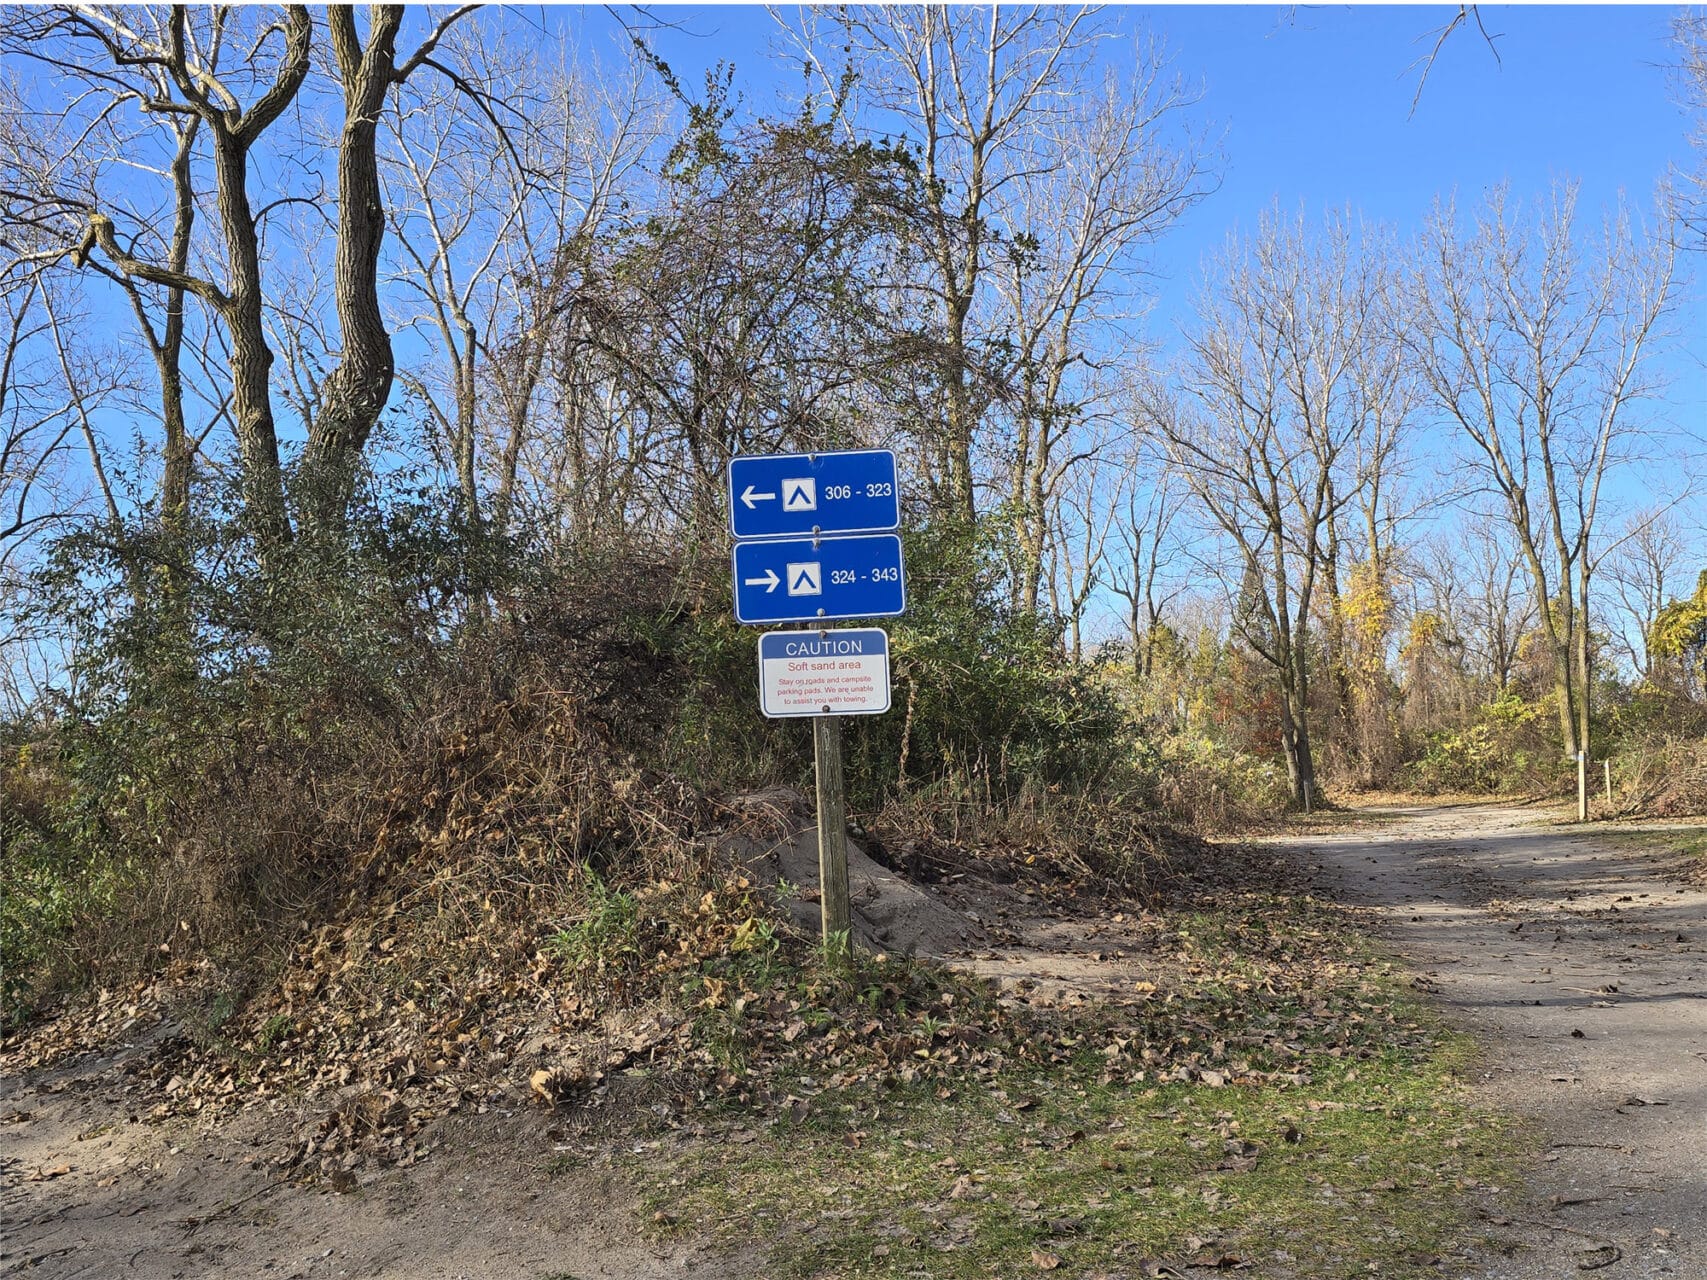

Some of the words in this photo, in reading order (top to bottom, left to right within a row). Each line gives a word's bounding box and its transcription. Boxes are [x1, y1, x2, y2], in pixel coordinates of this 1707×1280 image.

[825, 486, 851, 499] 306
[866, 484, 892, 497] 323
[831, 570, 856, 584] 324
[872, 568, 897, 582] 343
[786, 641, 862, 655] CAUTION
[788, 662, 808, 671] Soft
[811, 661, 836, 670] sand
[839, 661, 861, 670] area
[779, 678, 793, 687] Stay
[805, 677, 825, 685] roads
[841, 675, 871, 685] campsite
[777, 687, 802, 697] parking
[804, 687, 821, 696] pads.
[851, 685, 873, 693] unable
[814, 697, 826, 705] you
[844, 695, 867, 704] towing.
